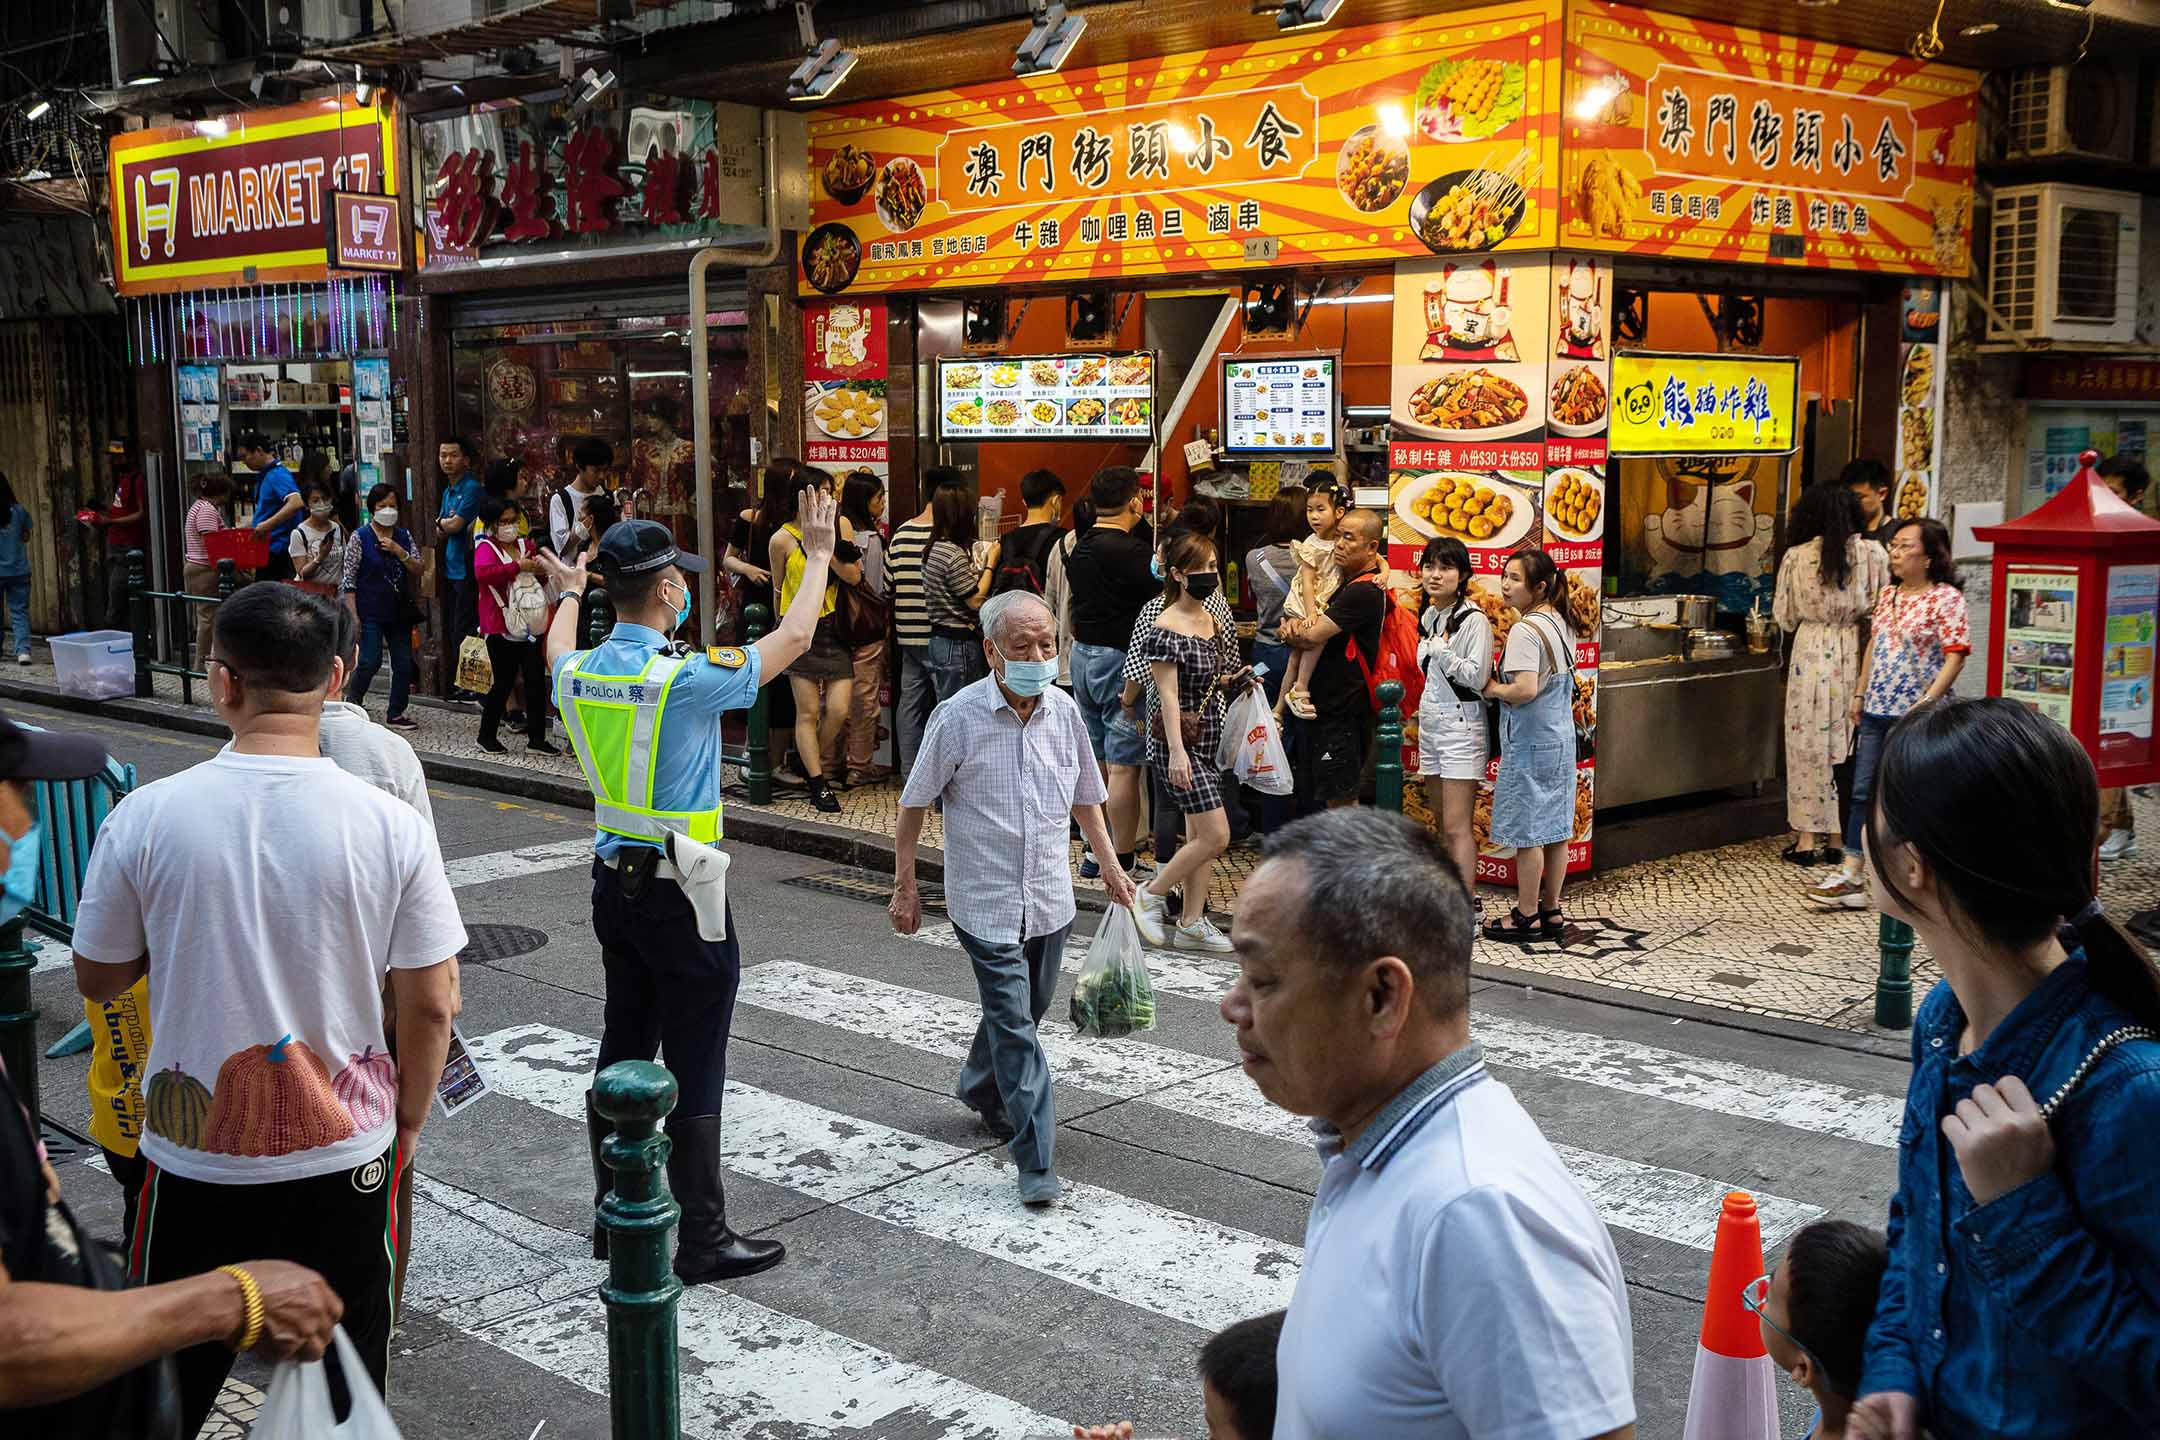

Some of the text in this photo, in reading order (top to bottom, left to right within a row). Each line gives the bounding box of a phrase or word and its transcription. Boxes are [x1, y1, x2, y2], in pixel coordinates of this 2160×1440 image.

[1658, 86, 1906, 181] 澳門街頭小食
[964, 102, 1303, 197] 澳門街頭小食
[189, 157, 323, 237] MARKET
[1651, 192, 1870, 233] 唔食唔得 炸雞 炸魷魚
[1014, 200, 1261, 248] 牛雜 咖哩魚旦 滷串
[343, 247, 397, 262] MARKET 17
[871, 241, 923, 261] 龍飛鳳舞
[1263, 240, 1270, 256] 8
[850, 446, 887, 460] $20/4個
[1394, 449, 1539, 467] 秘制牛雜 小份$30 大份$50
[585, 684, 625, 699] POLÍCIA
[628, 684, 645, 703] 察
[1476, 860, 1508, 879] $28
